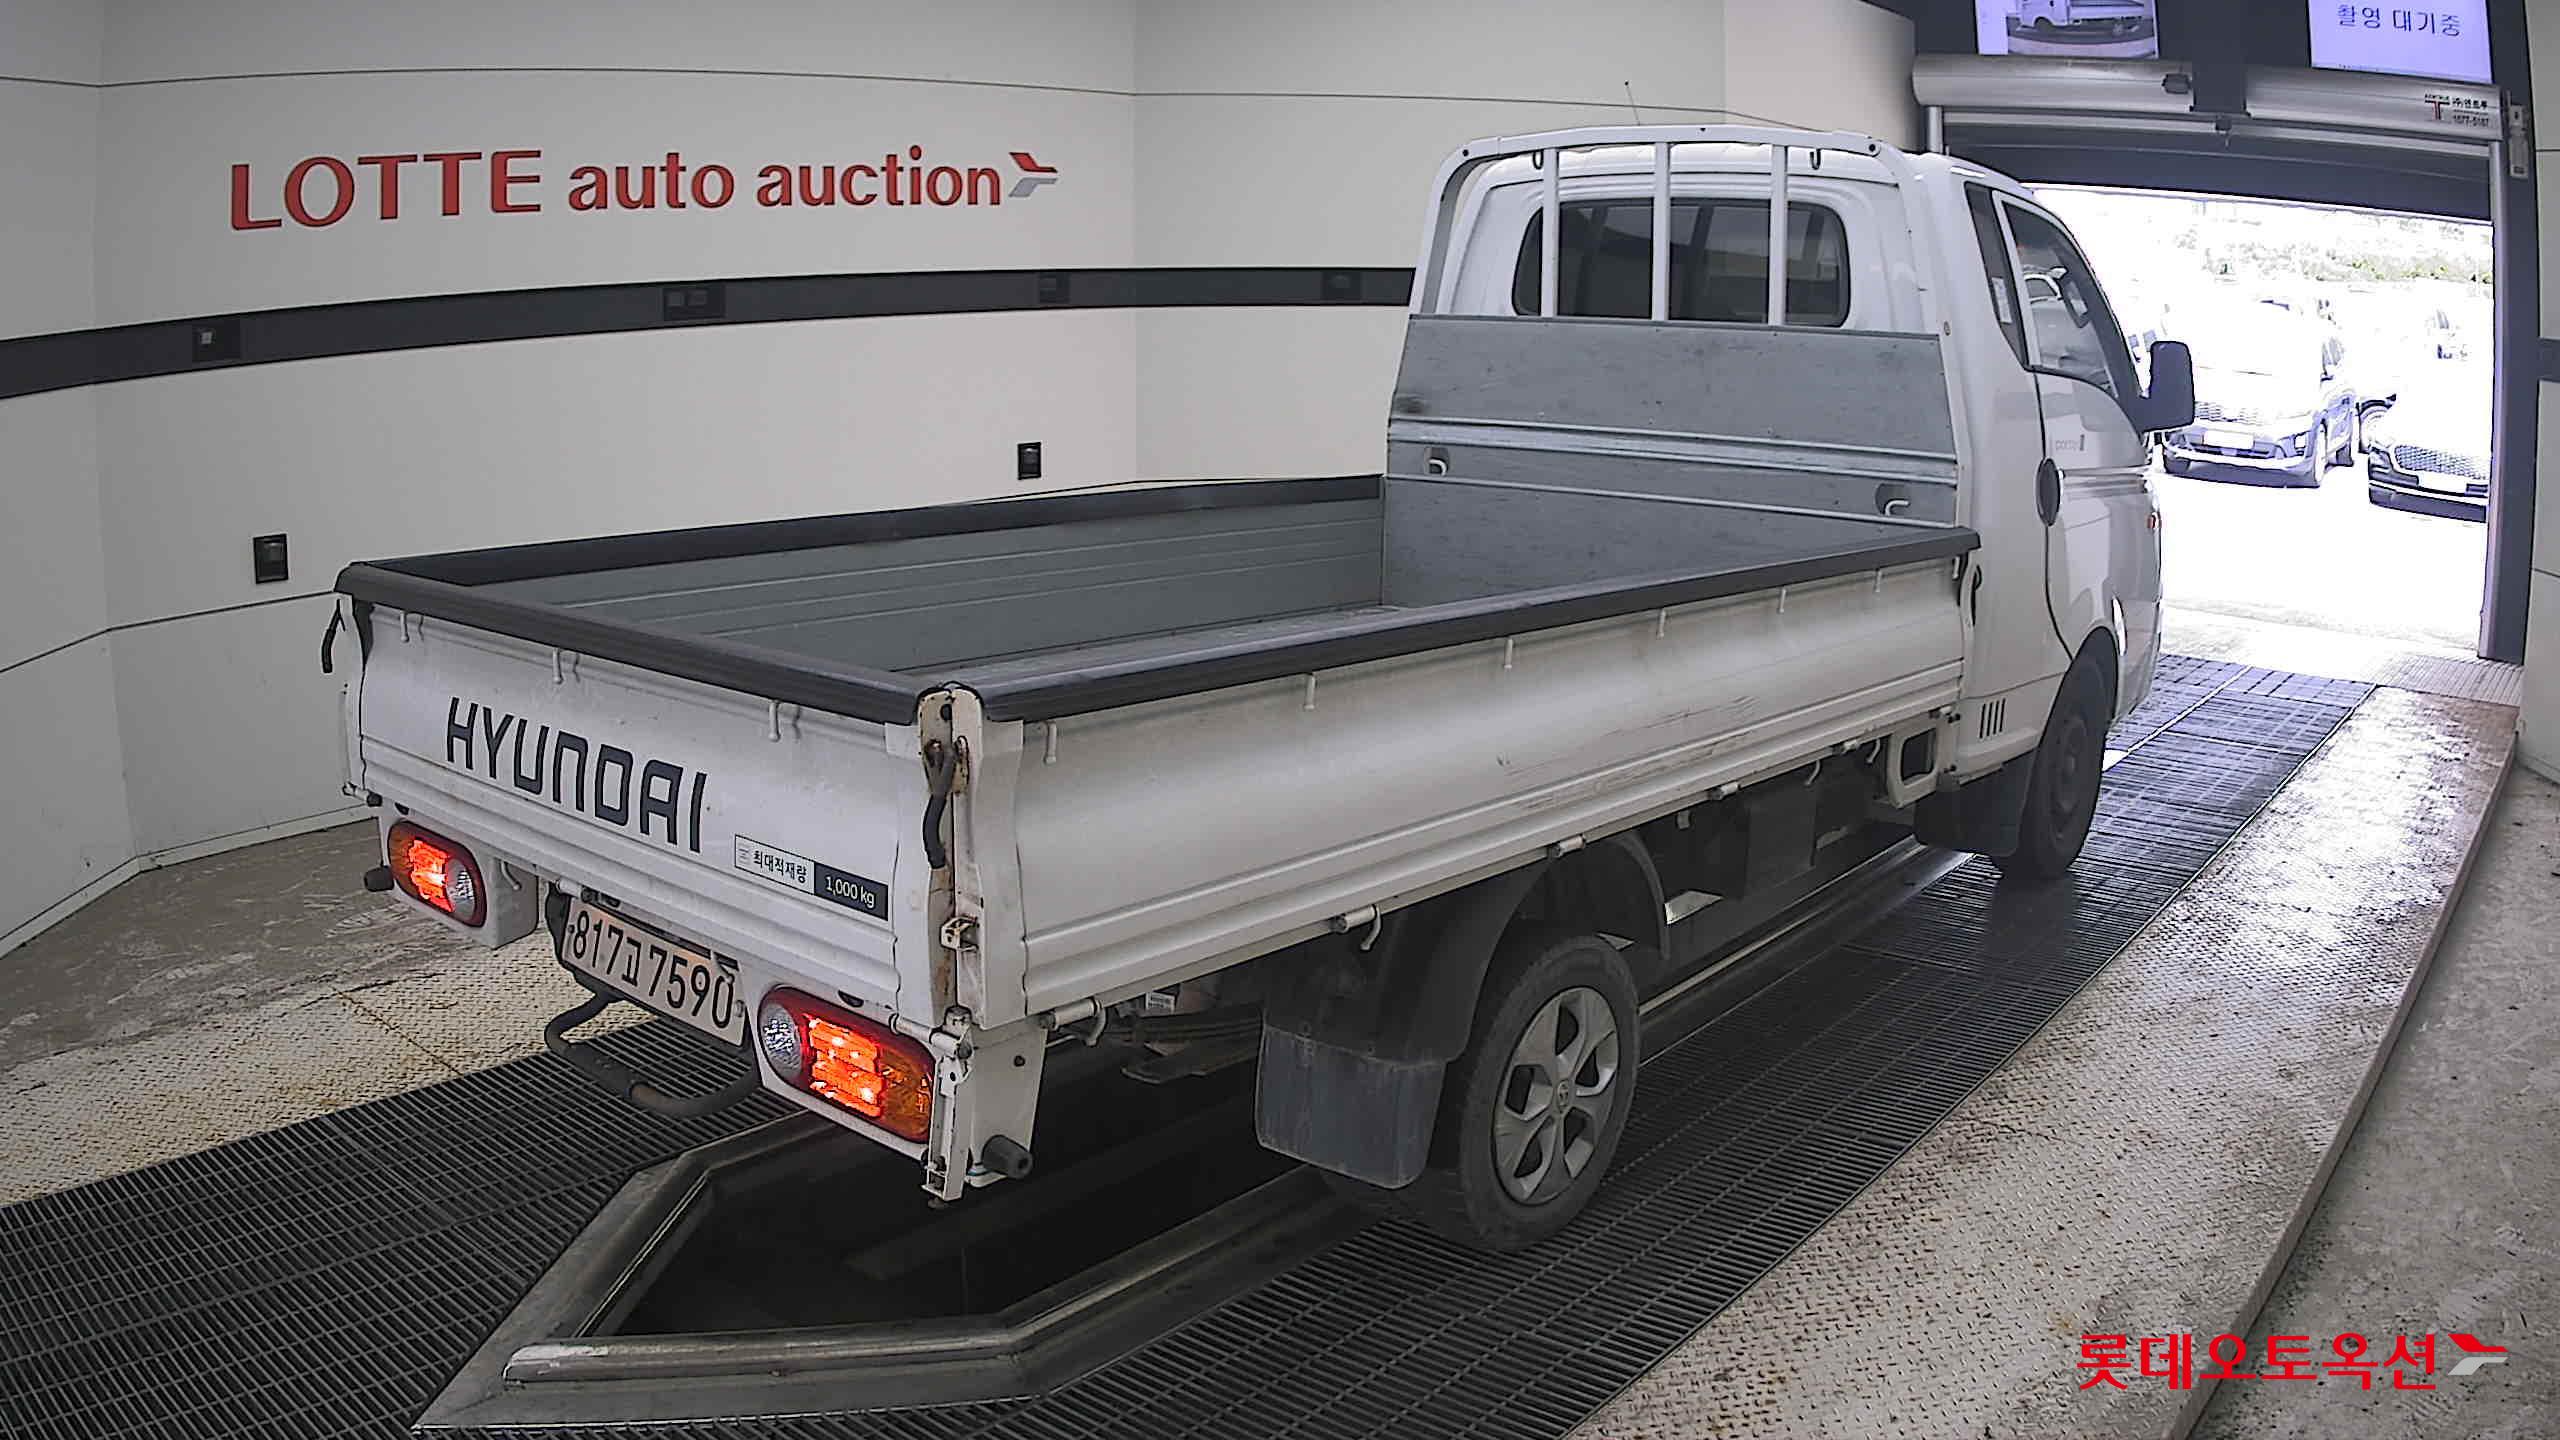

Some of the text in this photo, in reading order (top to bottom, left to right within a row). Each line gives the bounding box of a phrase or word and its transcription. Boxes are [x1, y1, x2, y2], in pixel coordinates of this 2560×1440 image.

[2337, 4, 2461, 37] 촬영 대기중
[231, 144, 1001, 231] LOTTE auto auction
[446, 696, 708, 854] HYUNDAI
[752, 849, 808, 884] 최대적재량
